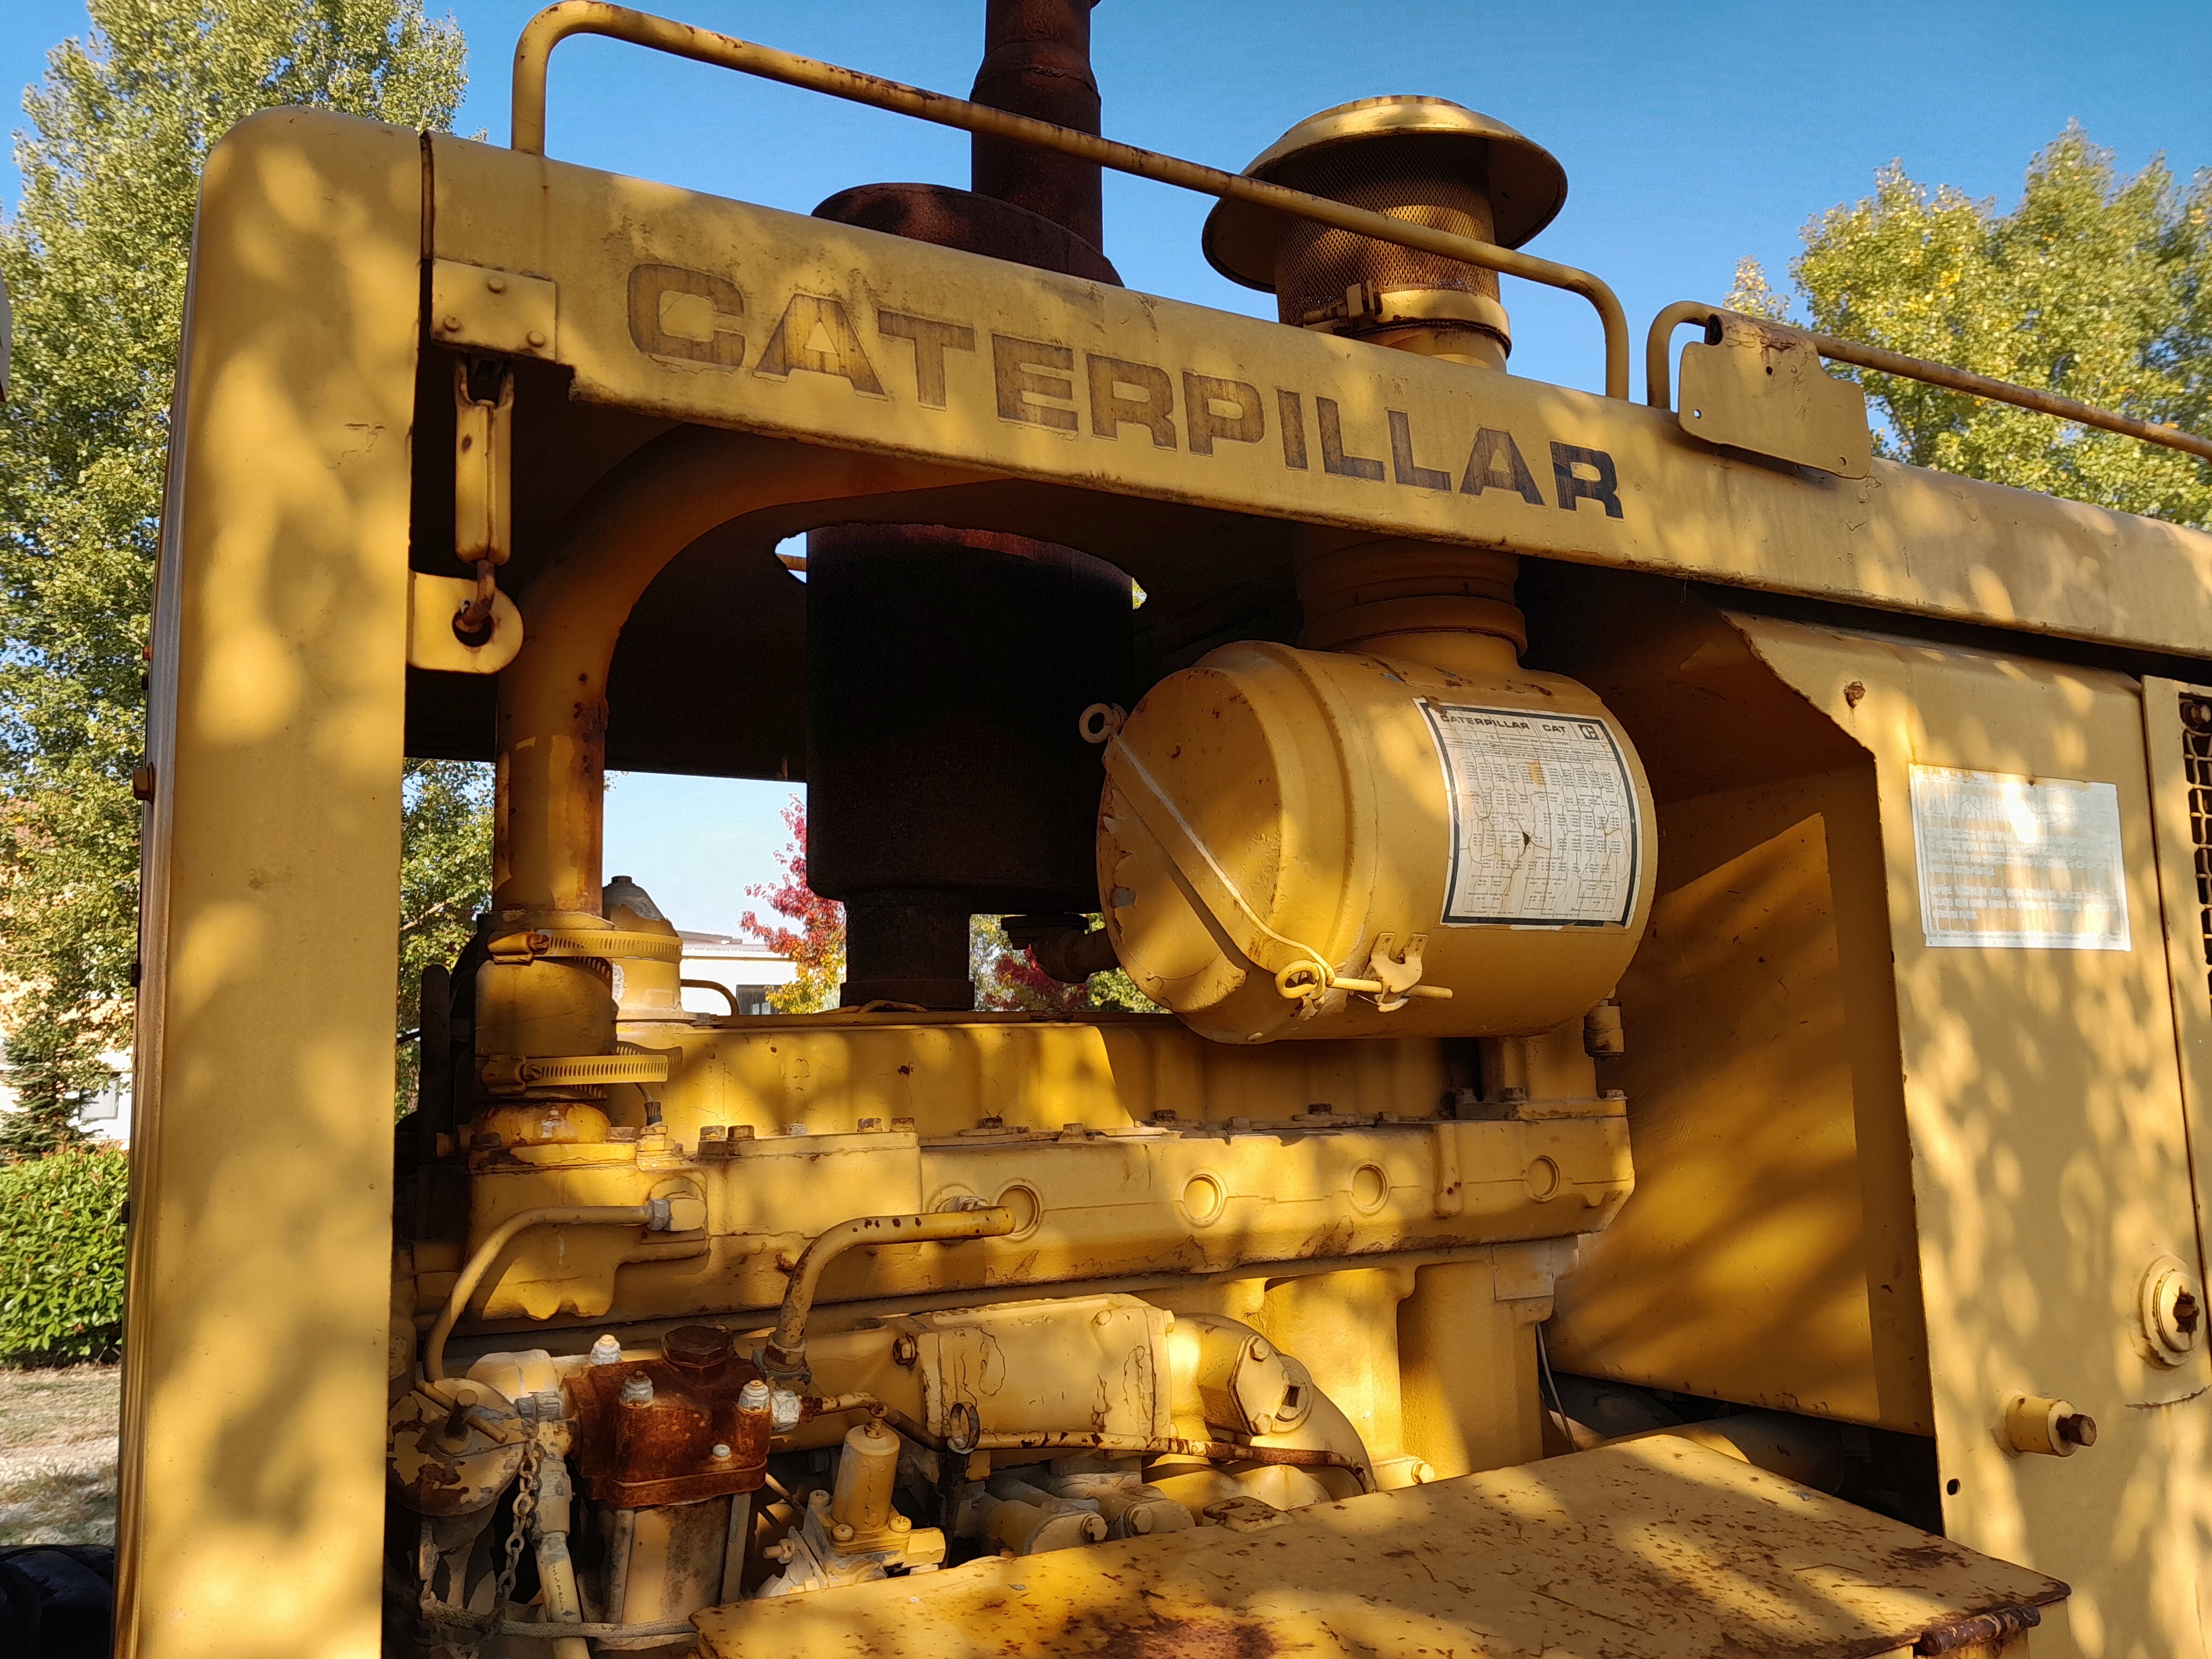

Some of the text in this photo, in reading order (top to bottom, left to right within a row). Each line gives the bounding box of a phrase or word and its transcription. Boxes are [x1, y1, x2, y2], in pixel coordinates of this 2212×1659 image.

[628, 262, 1624, 519] CATERPILLAR
[1441, 715, 1566, 733] CATERPILLAR CAT
